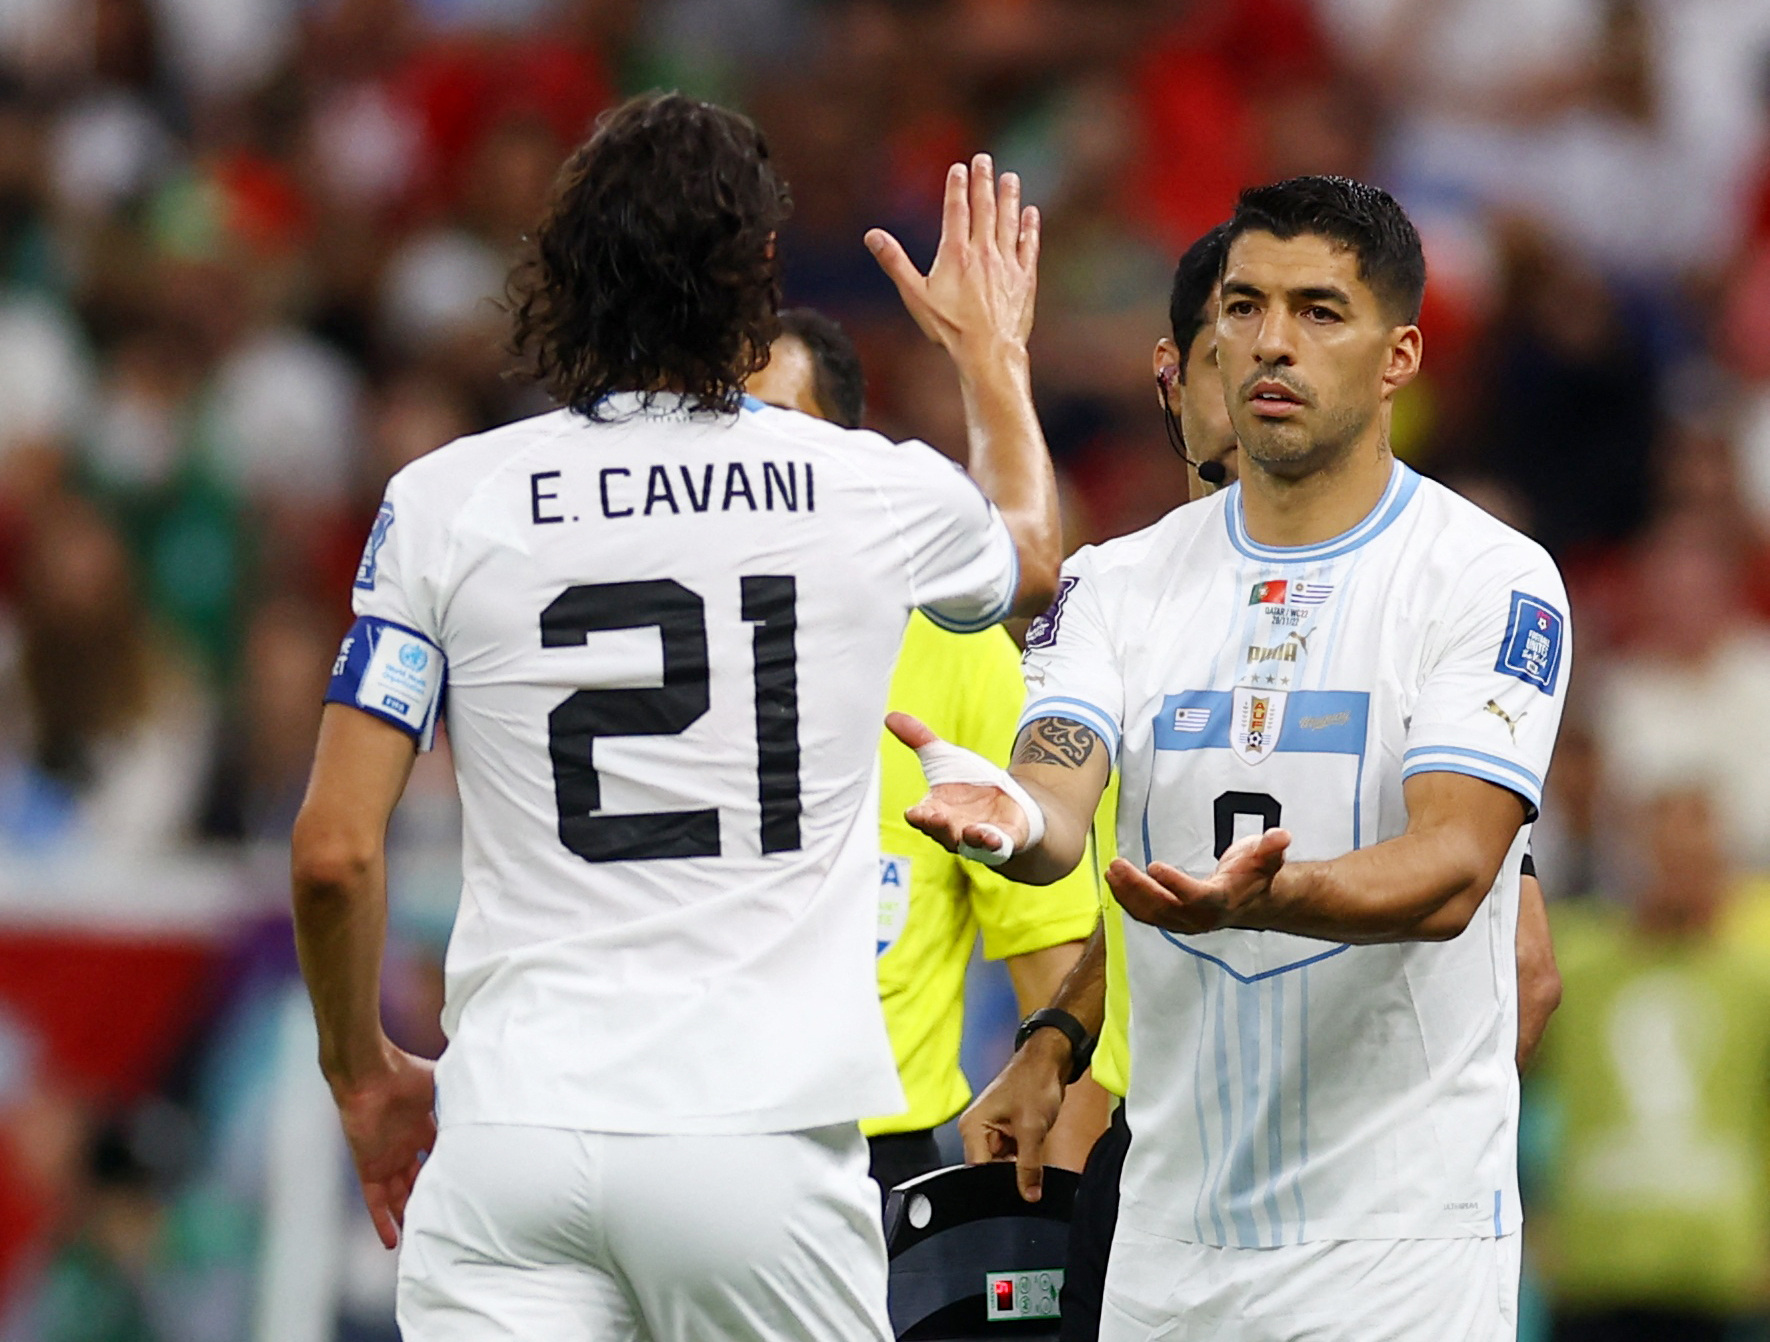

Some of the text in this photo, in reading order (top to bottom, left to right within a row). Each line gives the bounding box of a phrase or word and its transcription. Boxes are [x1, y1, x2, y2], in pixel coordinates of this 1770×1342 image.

[530, 461, 815, 525] E. CAVANI
[1265, 606, 1285, 615] QATAR
[1290, 608, 1308, 618] WC22
[1247, 642, 1298, 664] PUMA
[1526, 637, 1549, 658] UNITES
[540, 575, 802, 863] 21
[1252, 702, 1265, 728] AUF
